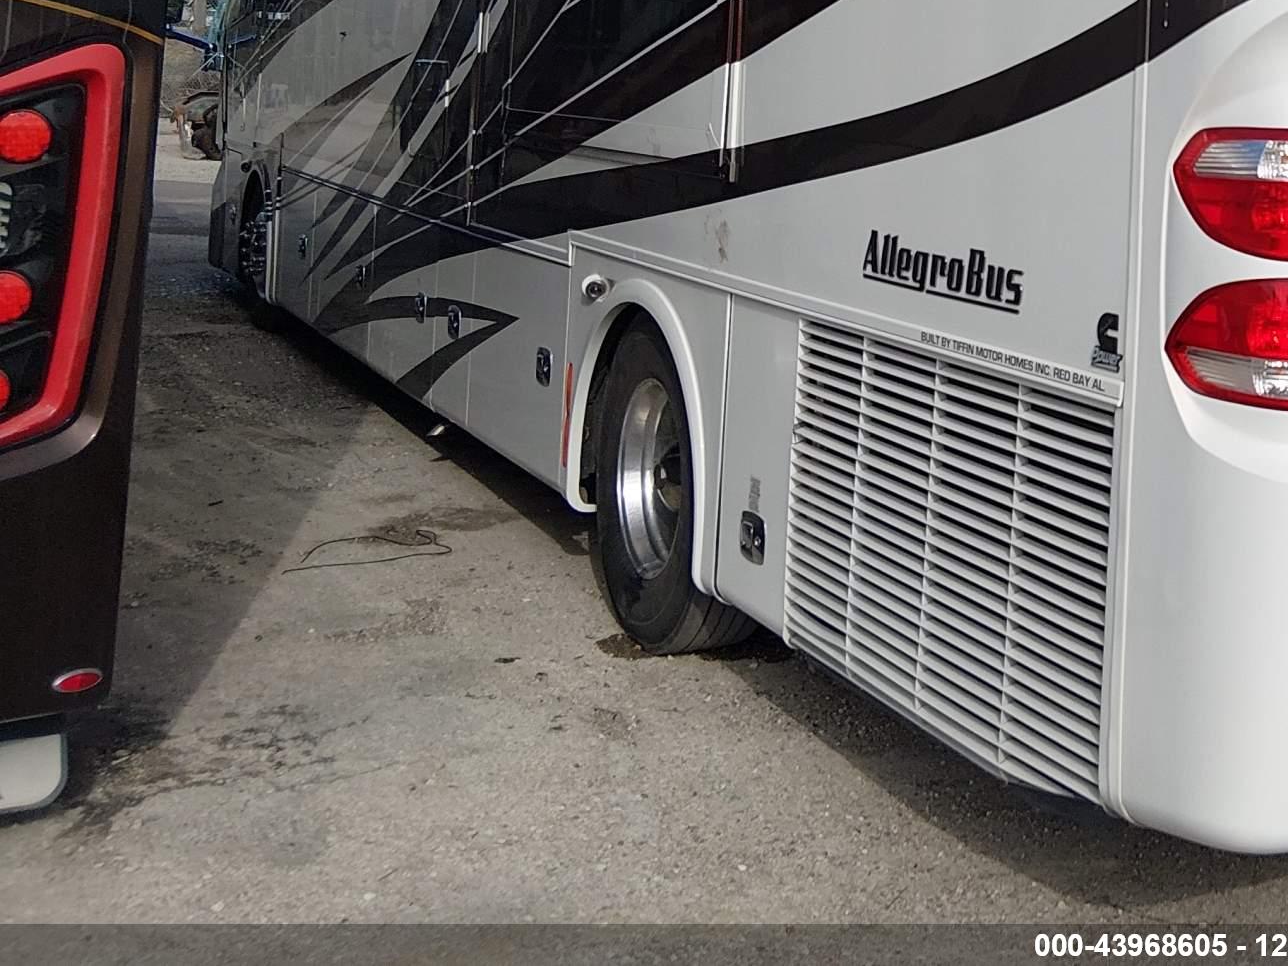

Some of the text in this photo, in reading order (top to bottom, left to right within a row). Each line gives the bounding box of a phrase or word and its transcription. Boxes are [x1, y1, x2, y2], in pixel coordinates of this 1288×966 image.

[863, 230, 1024, 307] AllegroBus
[920, 331, 940, 345] BUILT
[941, 336, 951, 349] BY
[952, 339, 975, 355] TIFFIN
[976, 346, 1003, 362] MOTOR
[1004, 353, 1034, 371] HOMES
[1053, 367, 1071, 382] RED
[1072, 372, 1092, 387] BAY
[1092, 346, 1122, 367] Power
